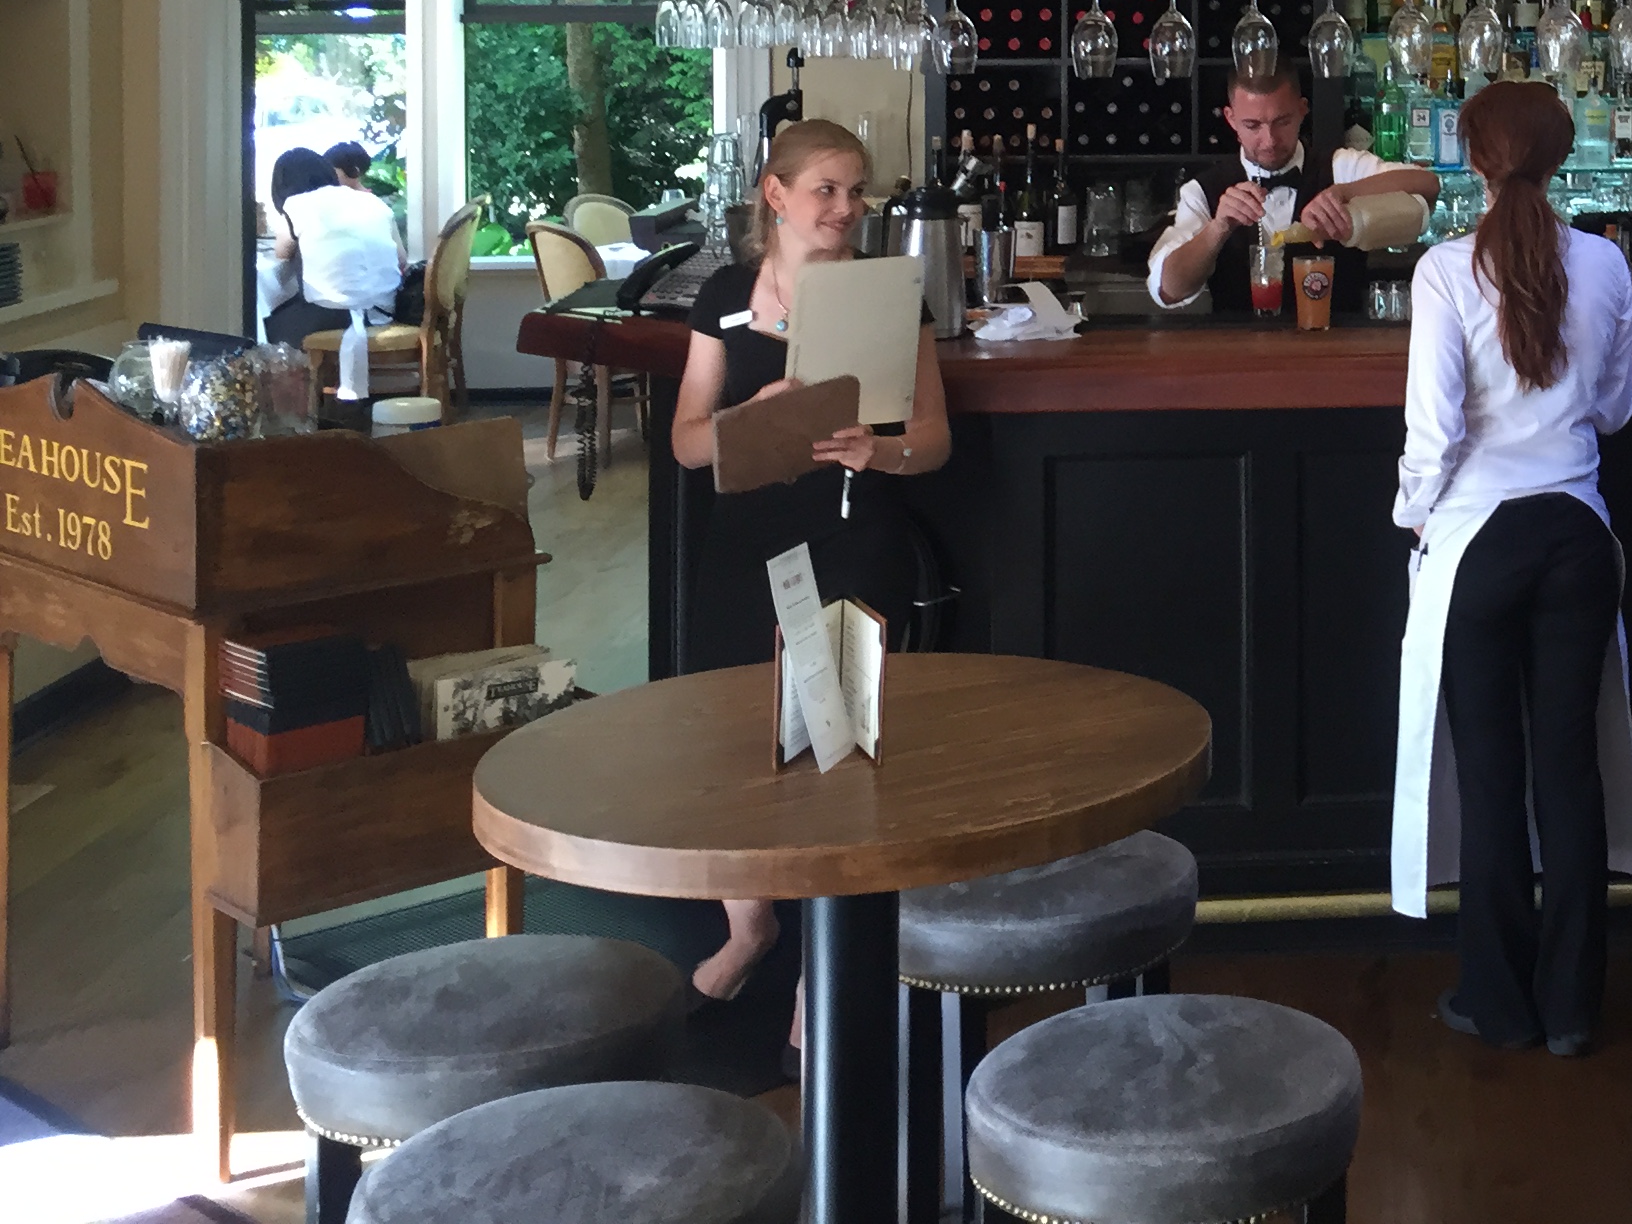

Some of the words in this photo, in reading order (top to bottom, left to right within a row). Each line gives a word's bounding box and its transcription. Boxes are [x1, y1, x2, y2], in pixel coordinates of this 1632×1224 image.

[0, 429, 149, 529] EAHOUSE
[5, 493, 52, 542] Est.
[57, 508, 112, 560] 1978
